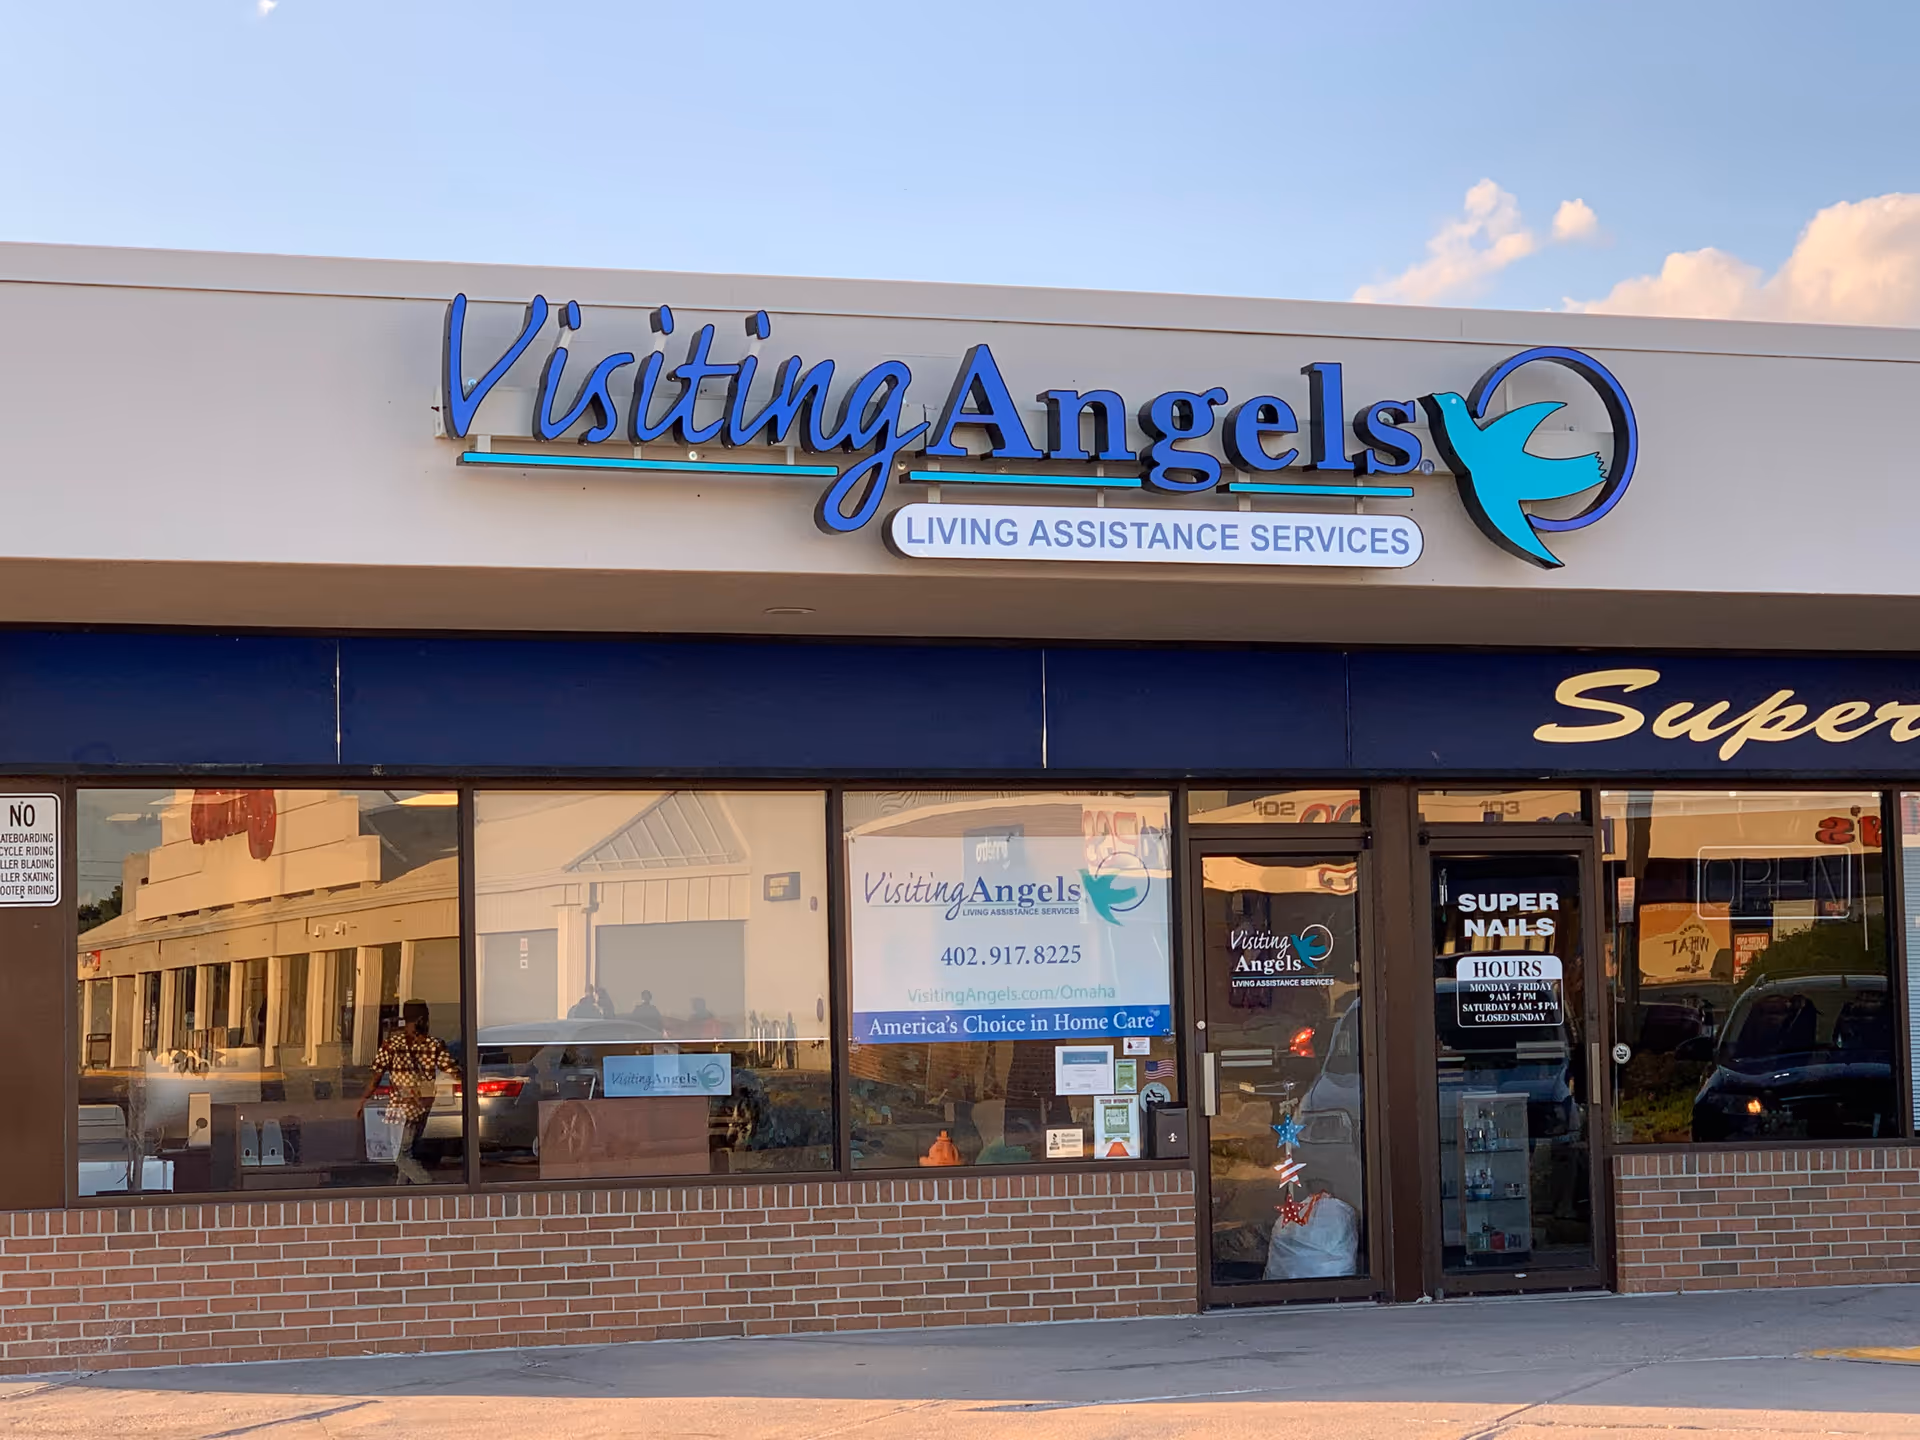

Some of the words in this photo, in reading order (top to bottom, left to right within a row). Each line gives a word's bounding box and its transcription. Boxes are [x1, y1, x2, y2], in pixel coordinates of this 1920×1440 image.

[447, 292, 931, 534] Visiting
[906, 516, 1019, 547] LIVING
[1028, 520, 1241, 552] ASSISTANCE
[1250, 525, 1411, 556] SERVICES
[1533, 668, 1920, 762] Super
[9, 804, 36, 828] NO
[1255, 800, 1297, 816] 102
[1479, 800, 1521, 815] 103
[25, 846, 54, 857] RIDING
[21, 859, 55, 870] BLADING
[22, 872, 54, 883] SKATING
[27, 885, 55, 896] RIDING
[864, 871, 969, 921] Visiting
[967, 875, 1082, 908] Angels
[1457, 892, 1559, 912] SUPER
[962, 908, 990, 917] LIVING
[990, 907, 1040, 916] ASSISTANCE
[1041, 907, 1080, 915] SERVICES
[1464, 917, 1556, 938] NAILS
[1230, 929, 1291, 959] Visiting
[940, 944, 1082, 967] 402.917.8225
[1234, 954, 1303, 976] Angels
[1472, 959, 1543, 978] HOURS
[1231, 980, 1255, 988] LIVING
[1256, 979, 1300, 988] ASSISTANCE
[1301, 978, 1335, 987] SERVICES
[1469, 983, 1511, 992] MONDAY
[1518, 982, 1553, 991] FRIDAY
[907, 984, 1116, 1006] VisitingAngels.com/Omaha
[1489, 993, 1495, 1002] 9
[1496, 993, 1511, 1001] AM
[1516, 992, 1522, 1001] 7
[1522, 992, 1537, 1001] PM
[1462, 1003, 1511, 1012] SATURDAY
[1511, 1003, 1517, 1011] 9
[1517, 1002, 1532, 1011] AM
[1544, 1001, 1559, 1010] PM
[868, 1015, 958, 1037] America's
[962, 1013, 1026, 1034] Choice
[1030, 1013, 1049, 1032] in
[1053, 1012, 1109, 1031] Home
[1475, 1014, 1510, 1023] CLOSED
[1511, 1012, 1547, 1021] SUNDAY
[611, 1072, 655, 1091] Visiting
[654, 1072, 698, 1085] Angels
